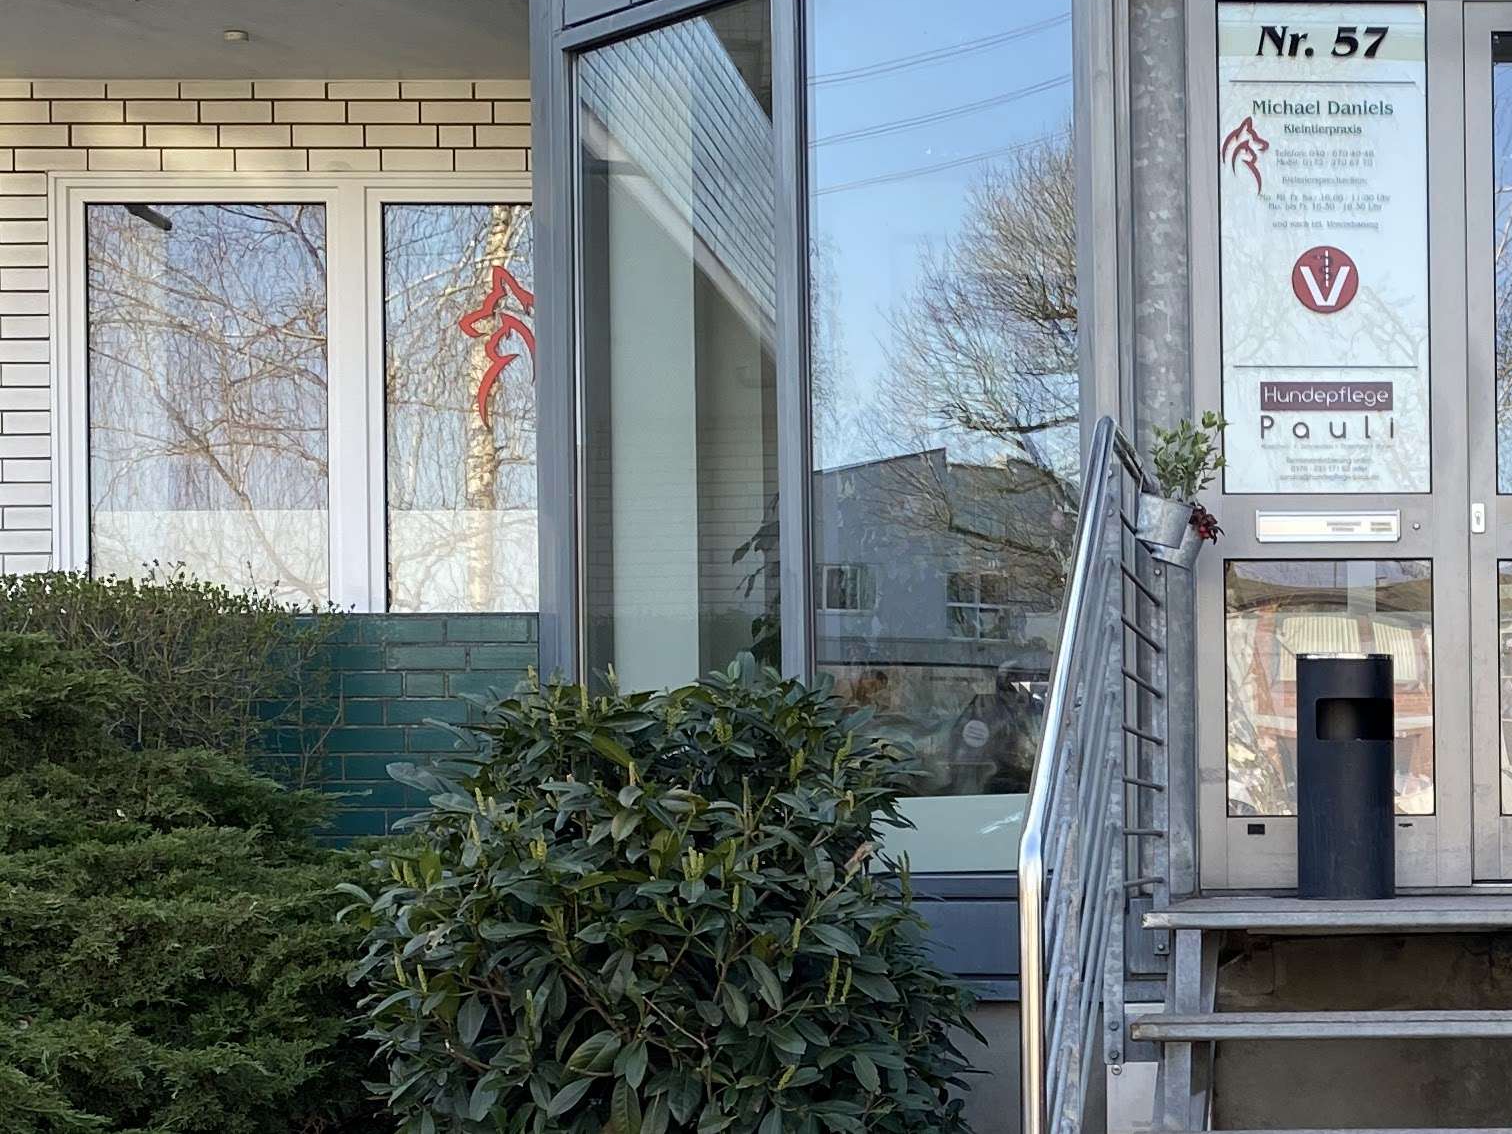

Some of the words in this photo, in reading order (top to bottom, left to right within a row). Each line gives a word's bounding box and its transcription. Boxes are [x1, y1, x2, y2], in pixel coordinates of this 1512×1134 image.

[1256, 25, 1315, 58] Nr.
[1331, 25, 1389, 59] 57
[1252, 99, 1321, 116] Michael
[1327, 99, 1394, 116] Daniels
[1283, 124, 1363, 136] Kleintierpraxis
[1264, 385, 1389, 407] Hundepflege
[1260, 414, 1394, 439] Pauli
